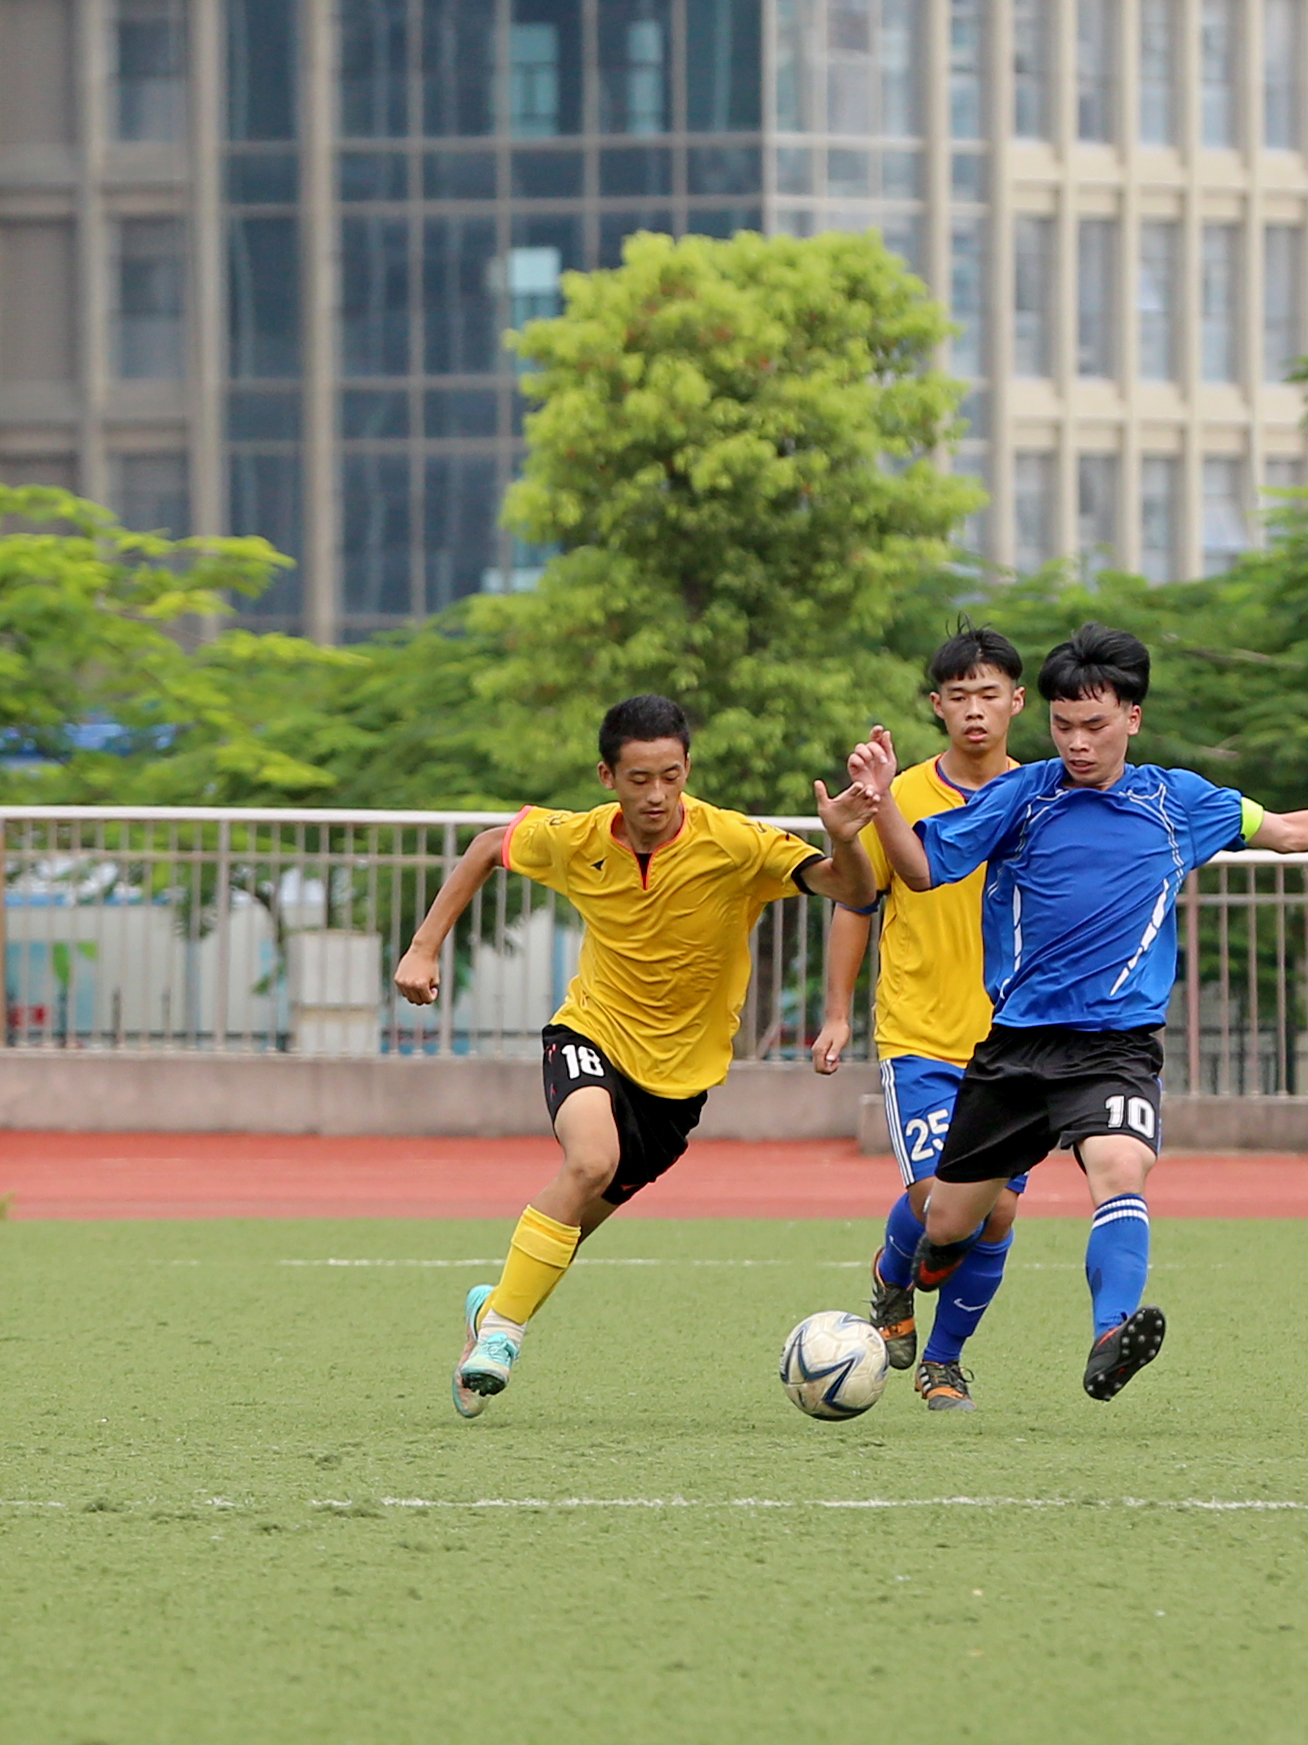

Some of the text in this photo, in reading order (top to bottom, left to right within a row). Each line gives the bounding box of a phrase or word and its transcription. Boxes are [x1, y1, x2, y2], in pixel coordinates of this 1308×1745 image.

[561, 1044, 604, 1079] 18
[906, 1108, 950, 1161] 25
[1105, 1095, 1155, 1138] 10
